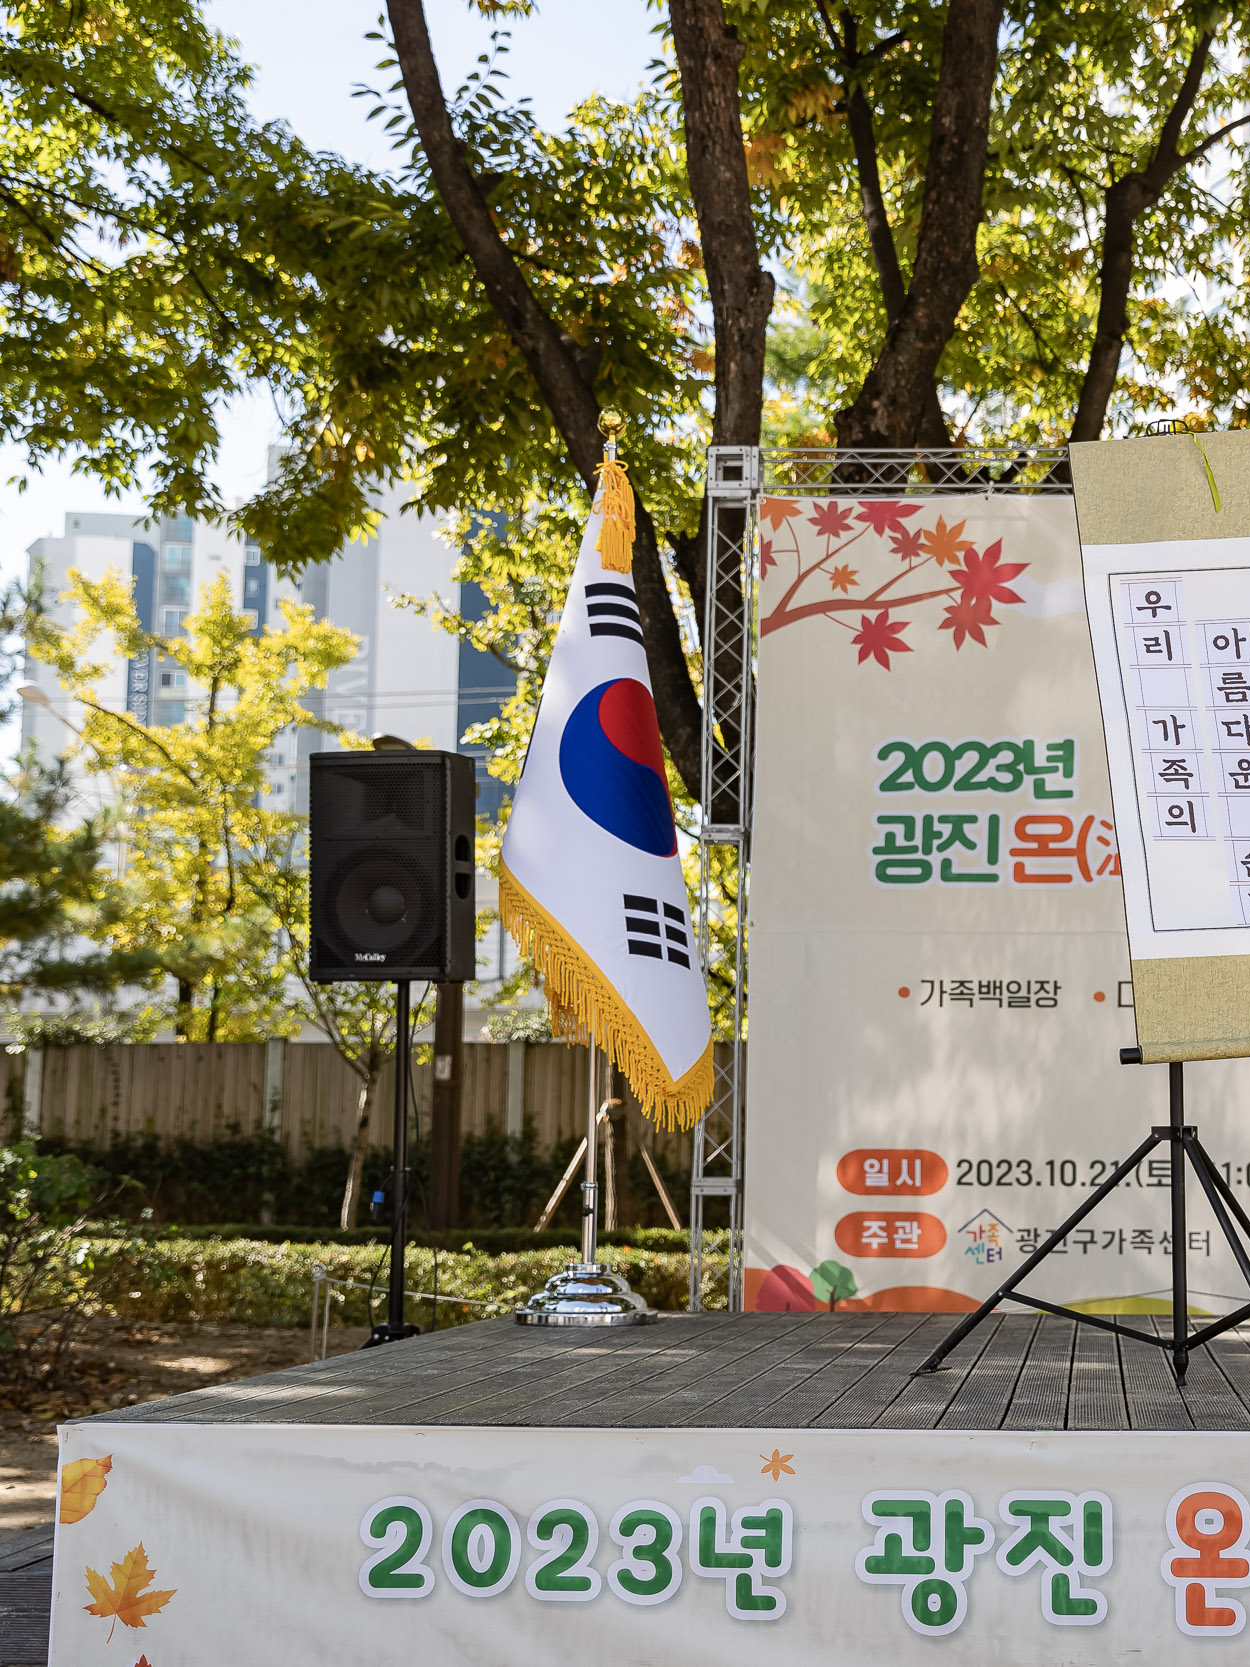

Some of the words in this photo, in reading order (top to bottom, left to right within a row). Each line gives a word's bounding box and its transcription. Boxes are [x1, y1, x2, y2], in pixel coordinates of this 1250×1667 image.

[1136, 589, 1174, 662] 우리
[876, 738, 1075, 800] 2023년
[1152, 714, 1198, 835] 가족의
[919, 979, 1062, 1008] 가족백일장
[863, 1158, 922, 1187] 일시
[861, 1220, 922, 1249] 주관
[367, 1503, 785, 1613] 2023년
[864, 1497, 1105, 1628] 광진
